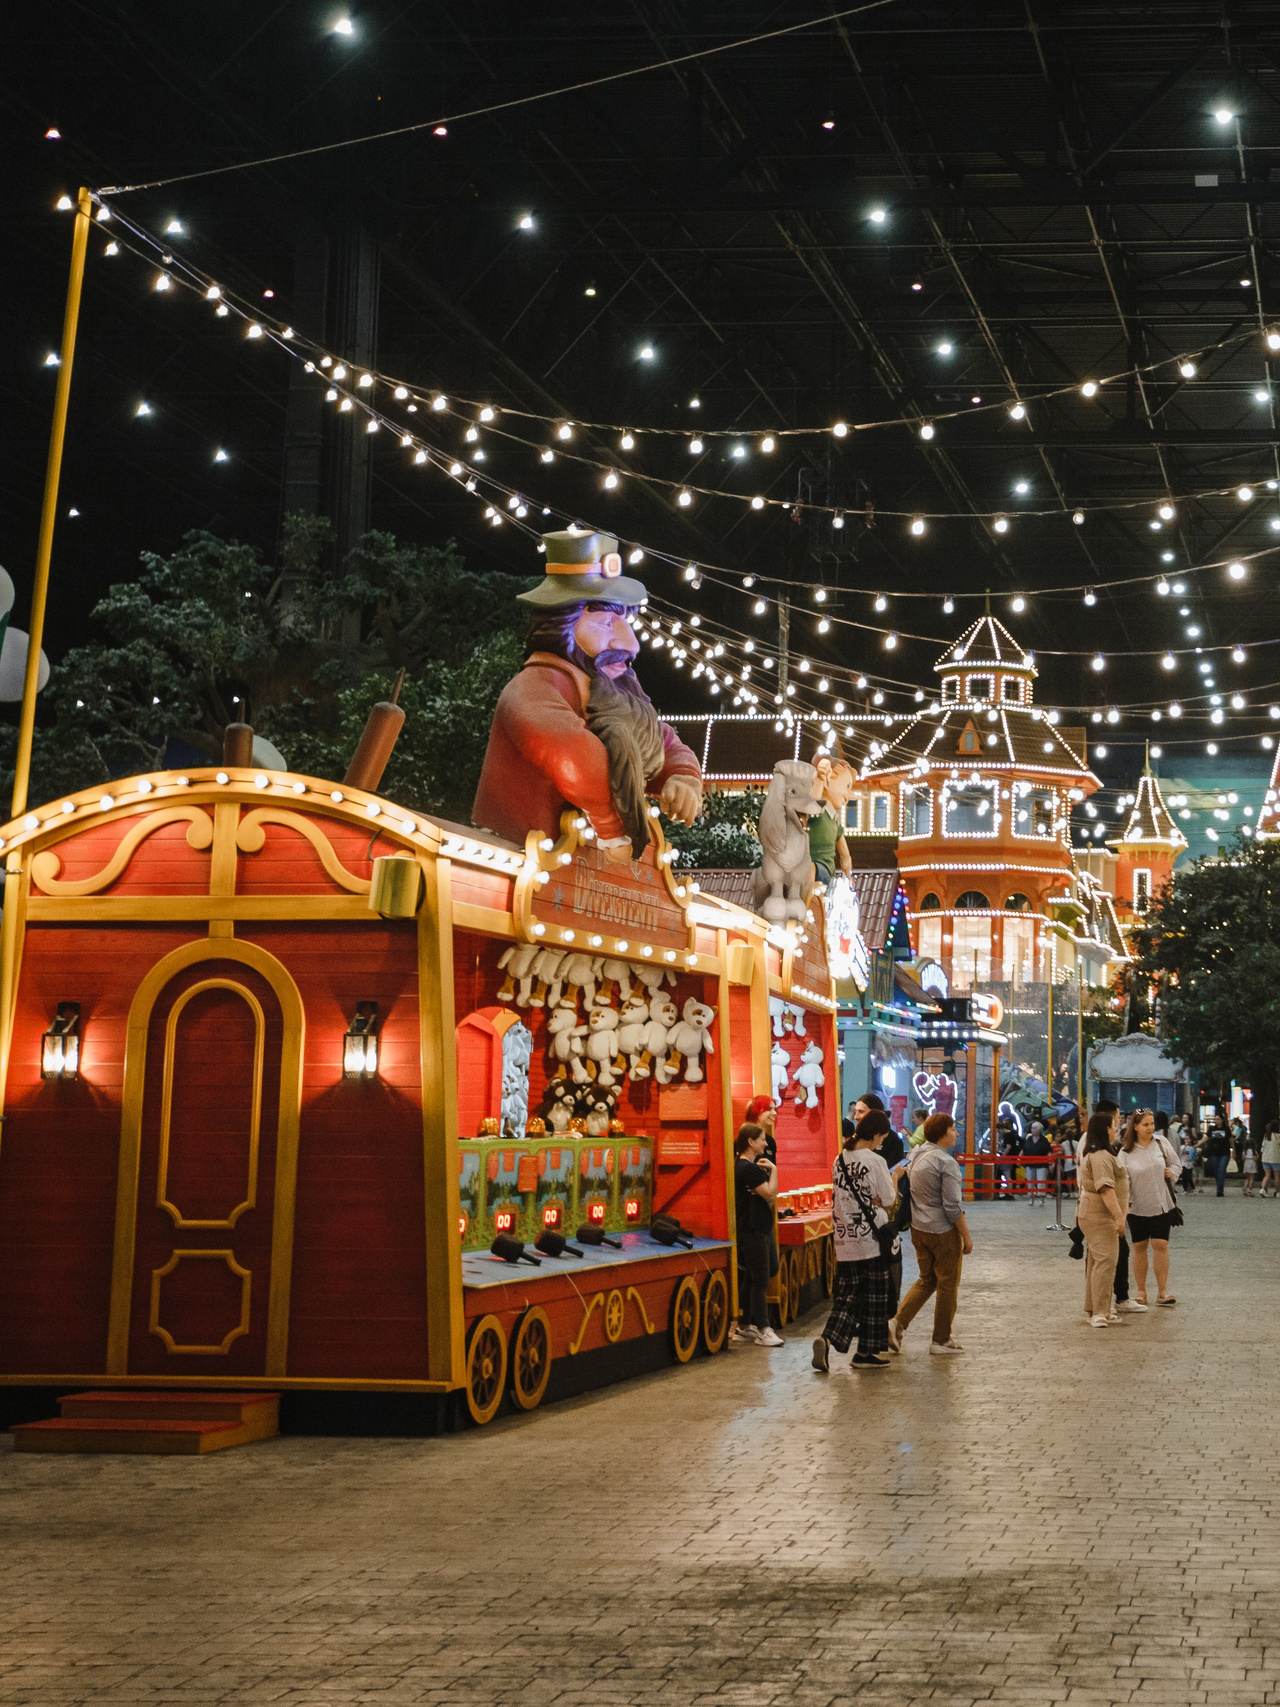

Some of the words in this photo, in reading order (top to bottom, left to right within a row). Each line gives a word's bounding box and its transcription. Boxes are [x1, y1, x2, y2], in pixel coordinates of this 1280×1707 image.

[592, 1205, 604, 1218] 00
[626, 1202, 638, 1215] 00
[497, 1214, 511, 1229] 00
[545, 1209, 558, 1223] 00
